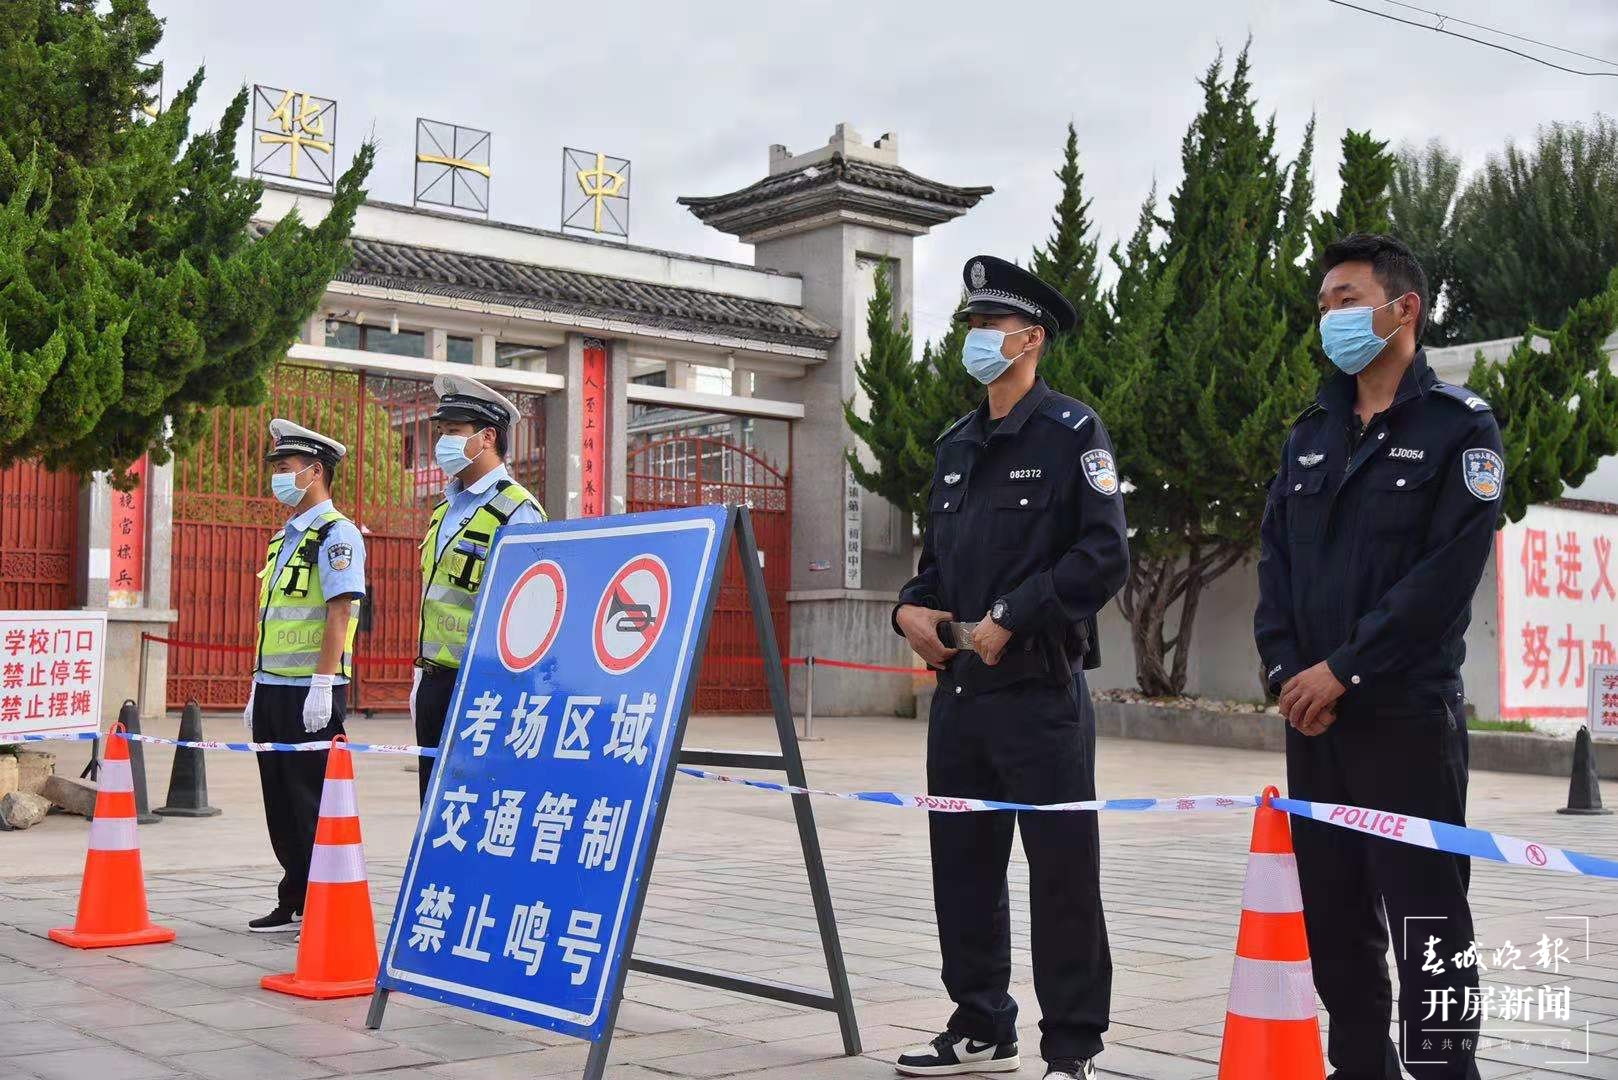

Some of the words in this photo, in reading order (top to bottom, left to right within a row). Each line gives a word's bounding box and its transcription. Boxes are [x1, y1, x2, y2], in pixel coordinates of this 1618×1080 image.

[1389, 447, 1425, 460] XJ0054
[1009, 469, 1042, 479] 082372
[1520, 528, 1617, 602] 促进义
[4, 628, 93, 656] 学校门口
[277, 629, 324, 646] POLIC
[3, 659, 92, 689] 禁止停车
[1, 690, 91, 722] 禁止摆摊
[459, 690, 658, 766] 考场区域
[432, 784, 632, 872] 交通管制
[1329, 805, 1409, 837] POLICE
[408, 882, 602, 986] 禁止鸣号
